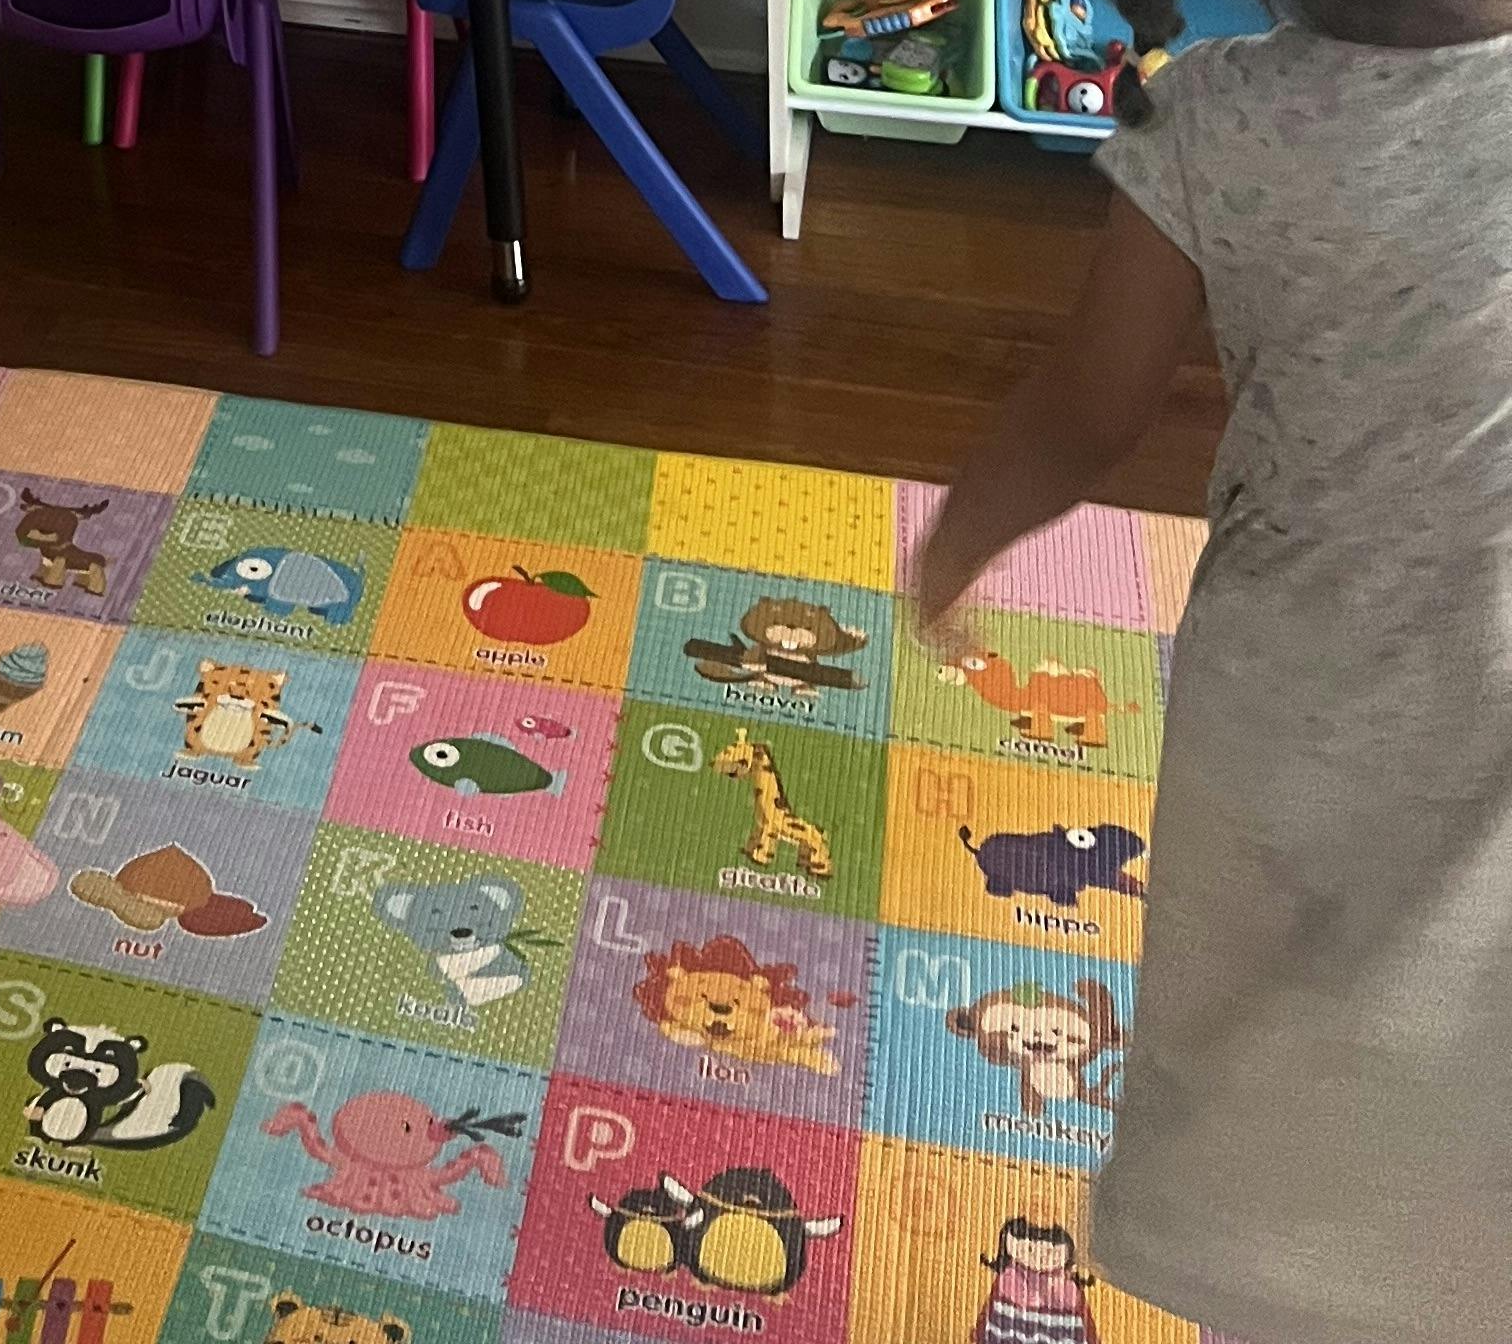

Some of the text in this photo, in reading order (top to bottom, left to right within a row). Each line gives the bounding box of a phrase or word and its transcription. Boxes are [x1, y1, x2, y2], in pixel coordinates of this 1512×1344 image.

[654, 569, 707, 613] B
[202, 608, 316, 640] elephant
[474, 646, 548, 669] apple
[366, 680, 428, 726] F
[642, 723, 703, 772] G
[996, 733, 1086, 762] camel
[161, 759, 253, 792] jaguar
[443, 808, 496, 837] fish
[592, 897, 646, 956] L
[1014, 905, 1101, 937] hippo
[112, 934, 164, 961] nut
[895, 948, 971, 1010] M
[564, 1107, 636, 1172] P
[13, 1144, 104, 1184] skunk
[304, 1212, 434, 1262] octopus
[197, 1264, 273, 1341] T
[615, 1285, 766, 1333] penguin
